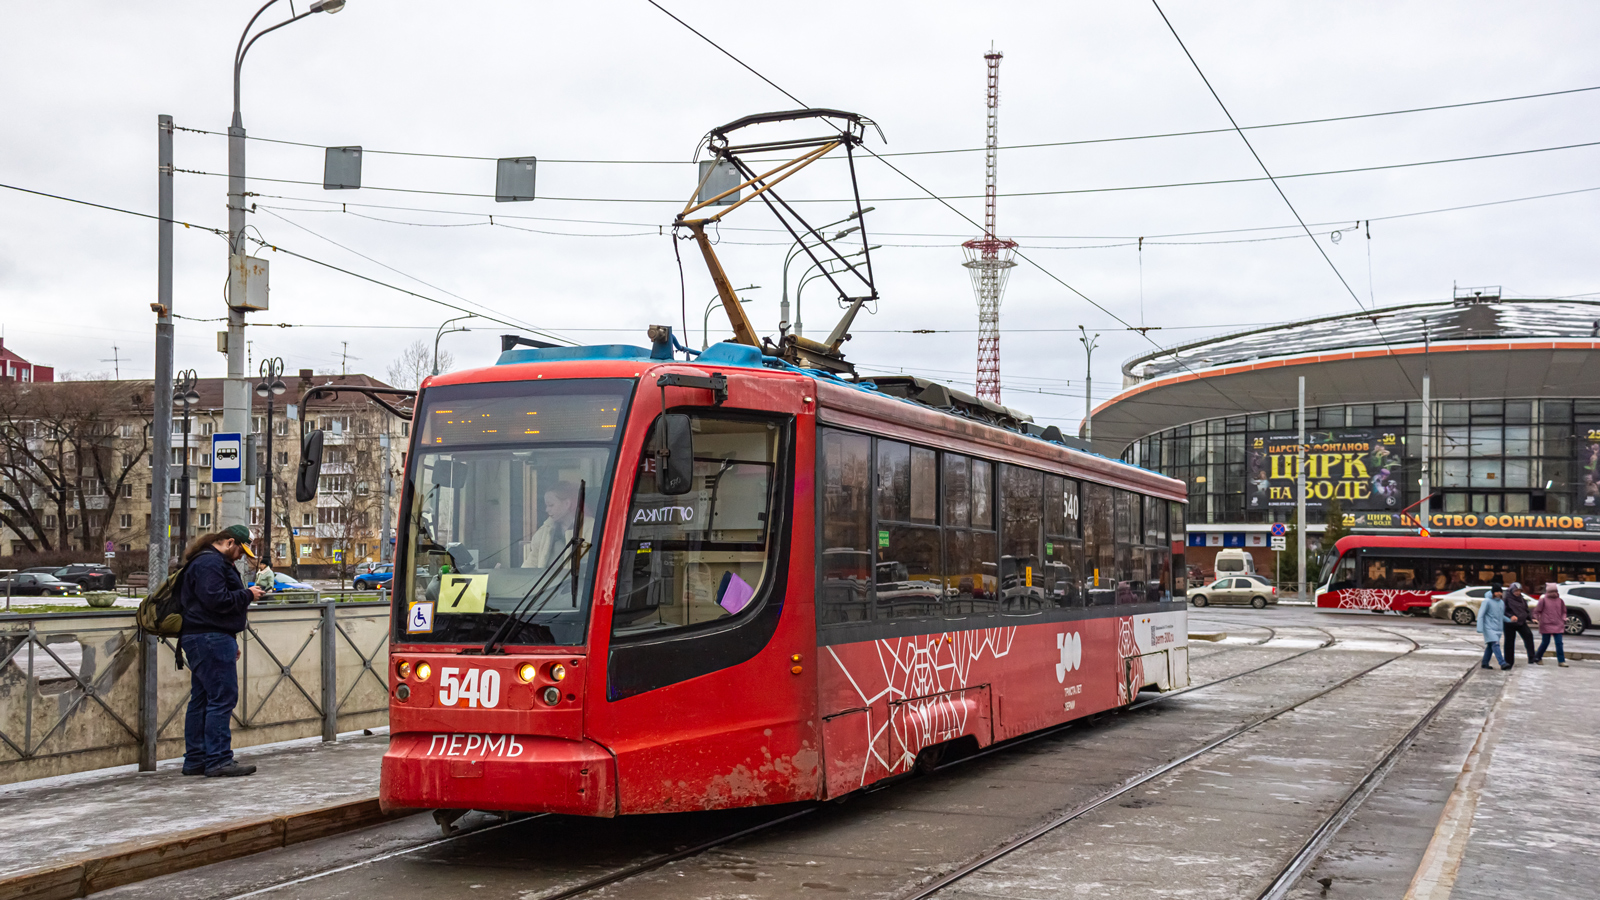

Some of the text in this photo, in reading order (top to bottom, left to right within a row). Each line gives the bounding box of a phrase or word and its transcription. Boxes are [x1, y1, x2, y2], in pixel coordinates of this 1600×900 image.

[1253, 437, 1264, 446] 25
[1382, 433, 1396, 442] 30
[1270, 453, 1371, 484] ЦИРК
[1269, 487, 1293, 499] НА
[1064, 492, 1079, 520] 540
[1342, 513, 1356, 523] 25
[1484, 515, 1584, 529] ФОНТАНОВ
[451, 577, 473, 608] 7
[439, 667, 501, 709] 540
[426, 734, 524, 758] ПЕРМЬ
